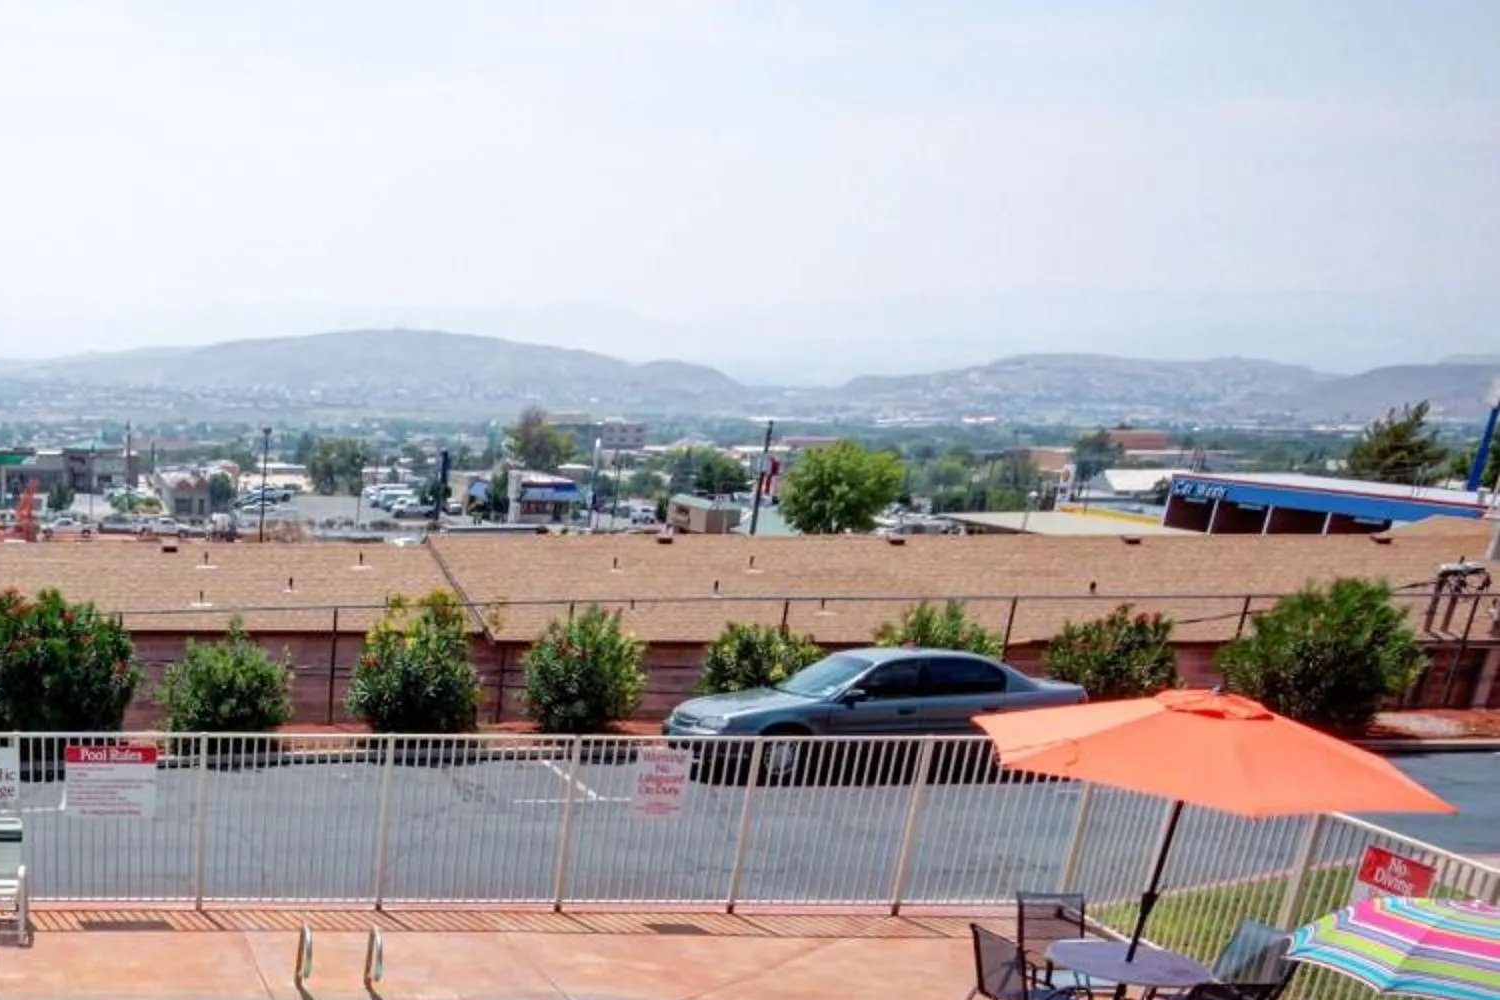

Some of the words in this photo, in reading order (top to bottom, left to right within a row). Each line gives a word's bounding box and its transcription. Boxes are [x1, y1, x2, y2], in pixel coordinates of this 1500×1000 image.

[80, 748, 107, 761] Pool
[109, 749, 143, 761] Rules
[1388, 856, 1408, 875] No
[1373, 867, 1415, 897] Diving
